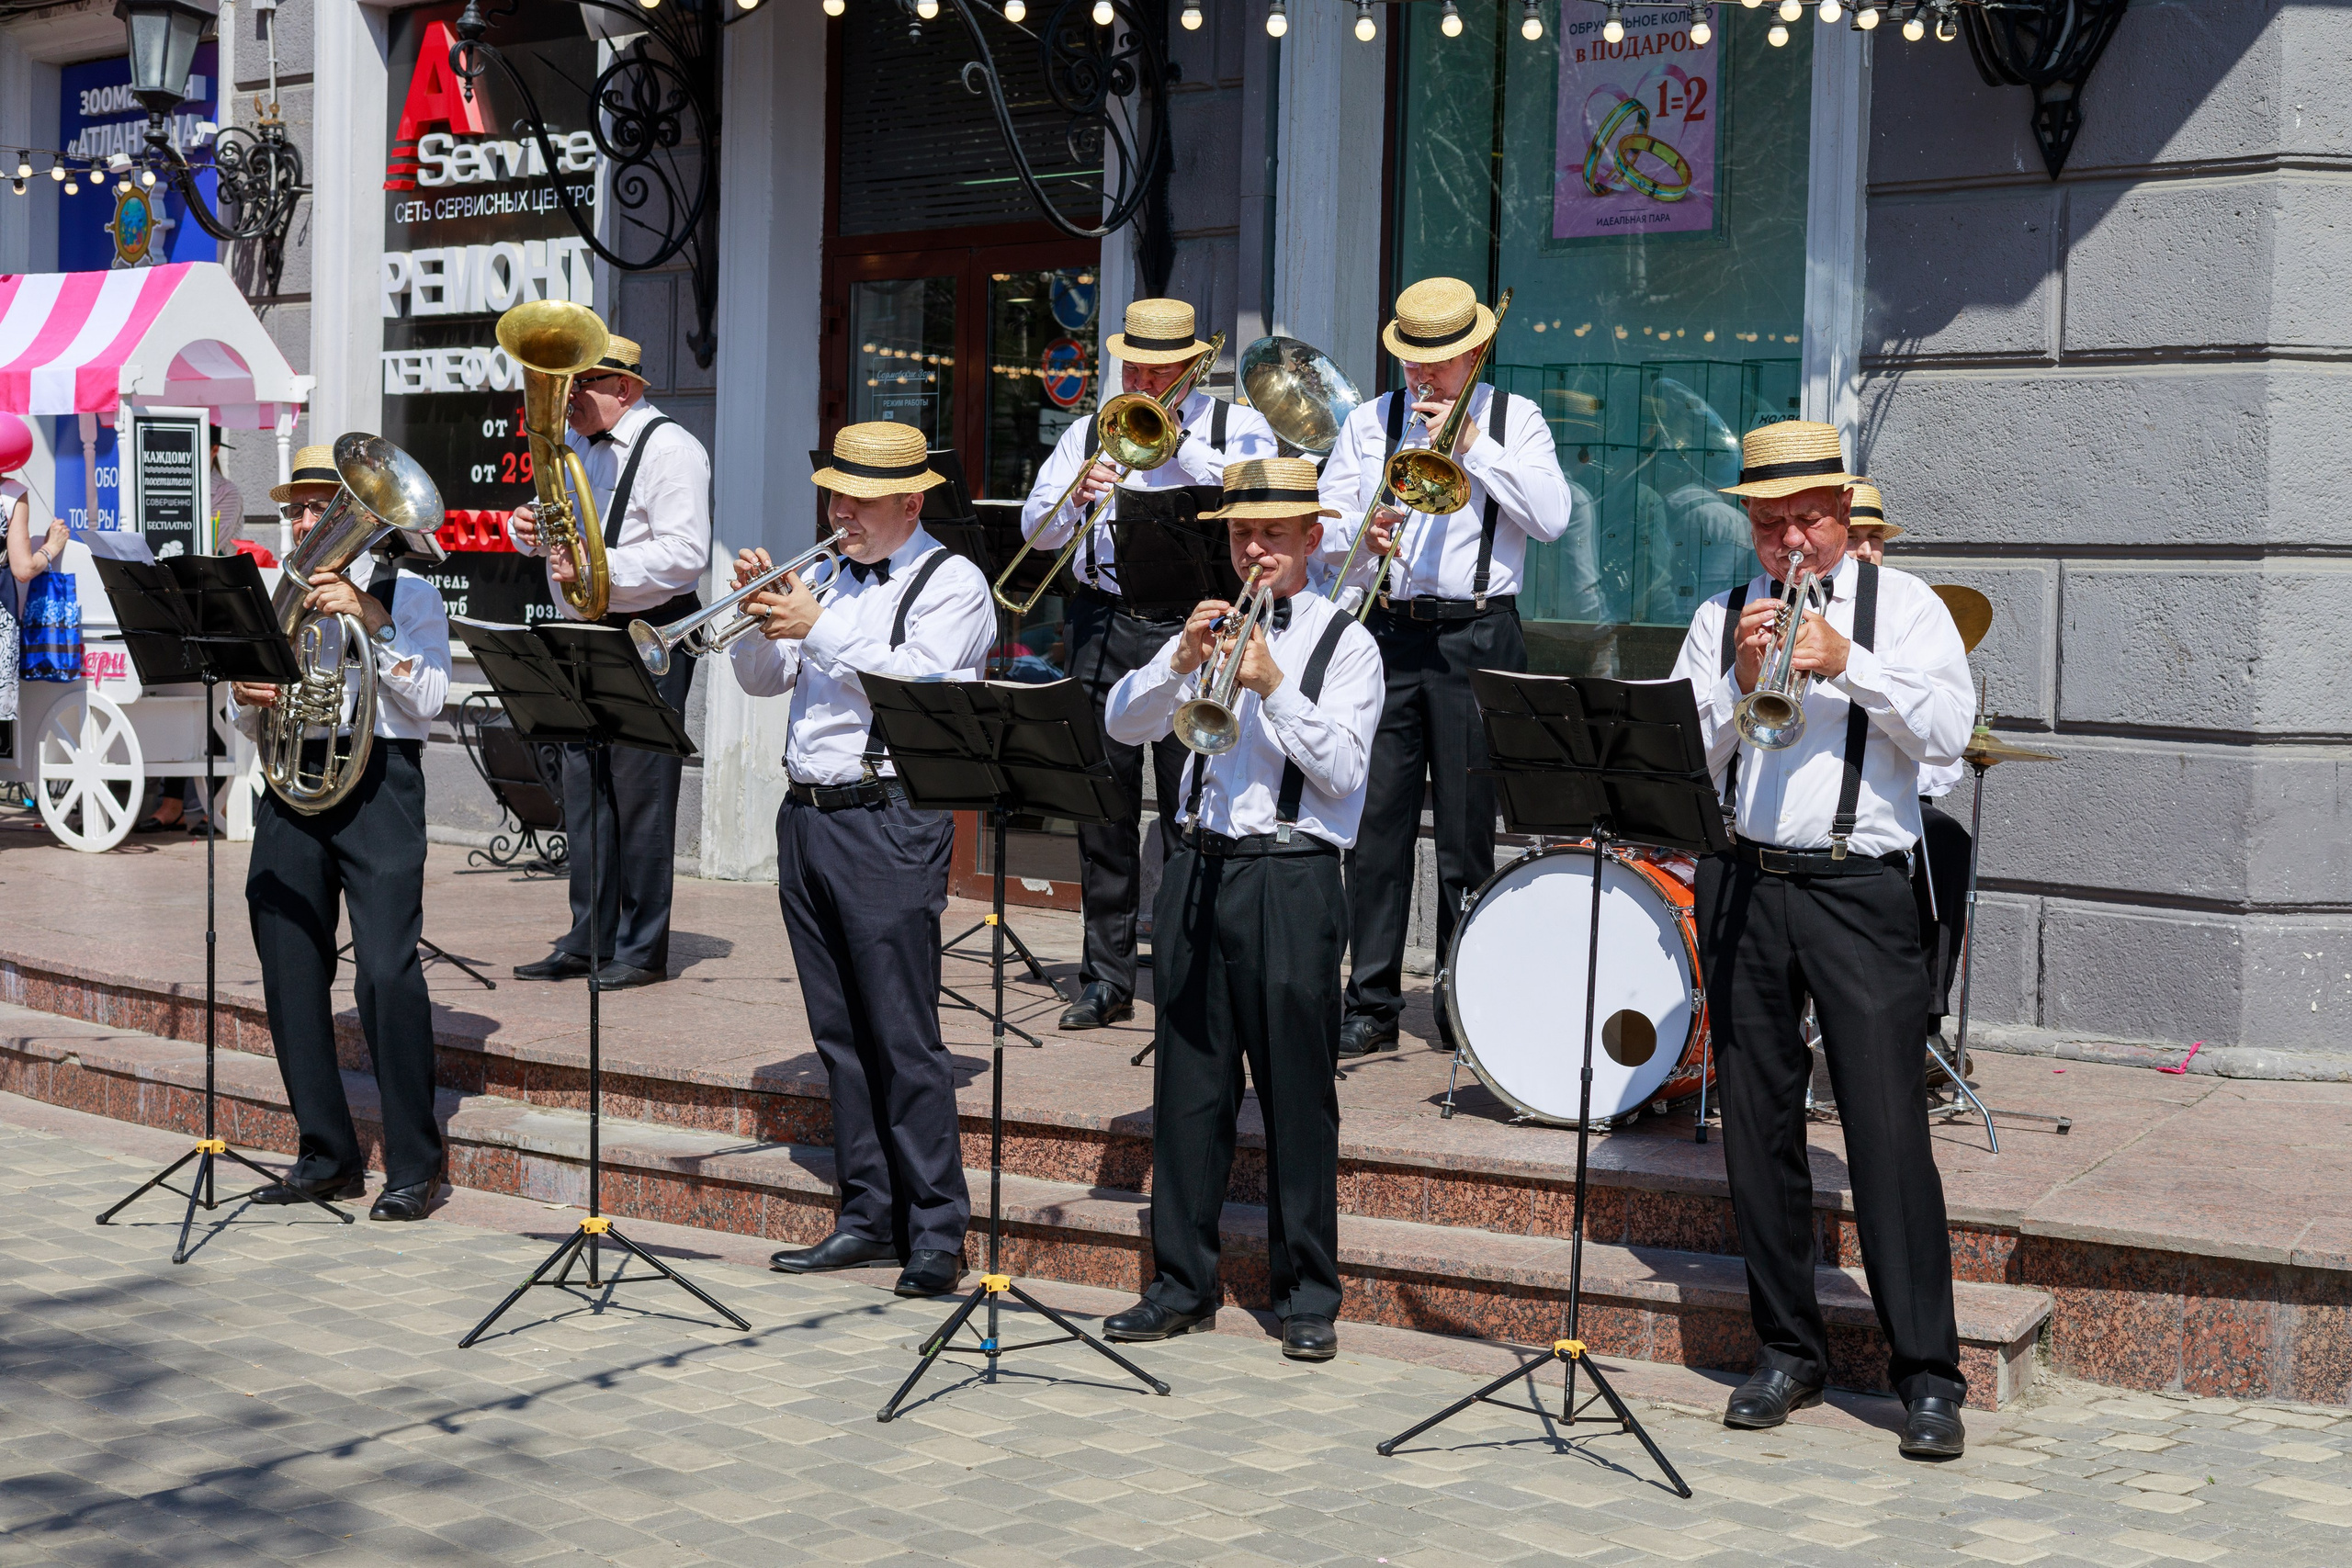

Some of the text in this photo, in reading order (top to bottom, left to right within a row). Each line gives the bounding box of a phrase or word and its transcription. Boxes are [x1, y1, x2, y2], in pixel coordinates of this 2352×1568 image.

[1569, 7, 1713, 36] ОБРУЬНОЕ КОЛЬО
[1656, 76, 1708, 123] 1=2
[417, 123, 597, 187] Service
[394, 200, 432, 224] СЕТЬ
[435, 189, 529, 220] СЕРВИСНЫХ
[1596, 212, 1671, 227] ИДЕАЛЬНАЯ ПАРА
[381, 236, 593, 318] РЕМОНТ
[883, 398, 929, 407] РЕЖИМ РАБОТЫ
[143, 451, 192, 465] КАЖДОМУ
[145, 498, 191, 507] СОВЕРШЕННО
[68, 508, 115, 529] ТОВРЫ
[146, 521, 193, 531] БЕСПЛАТНО
[419, 574, 469, 590] огель
